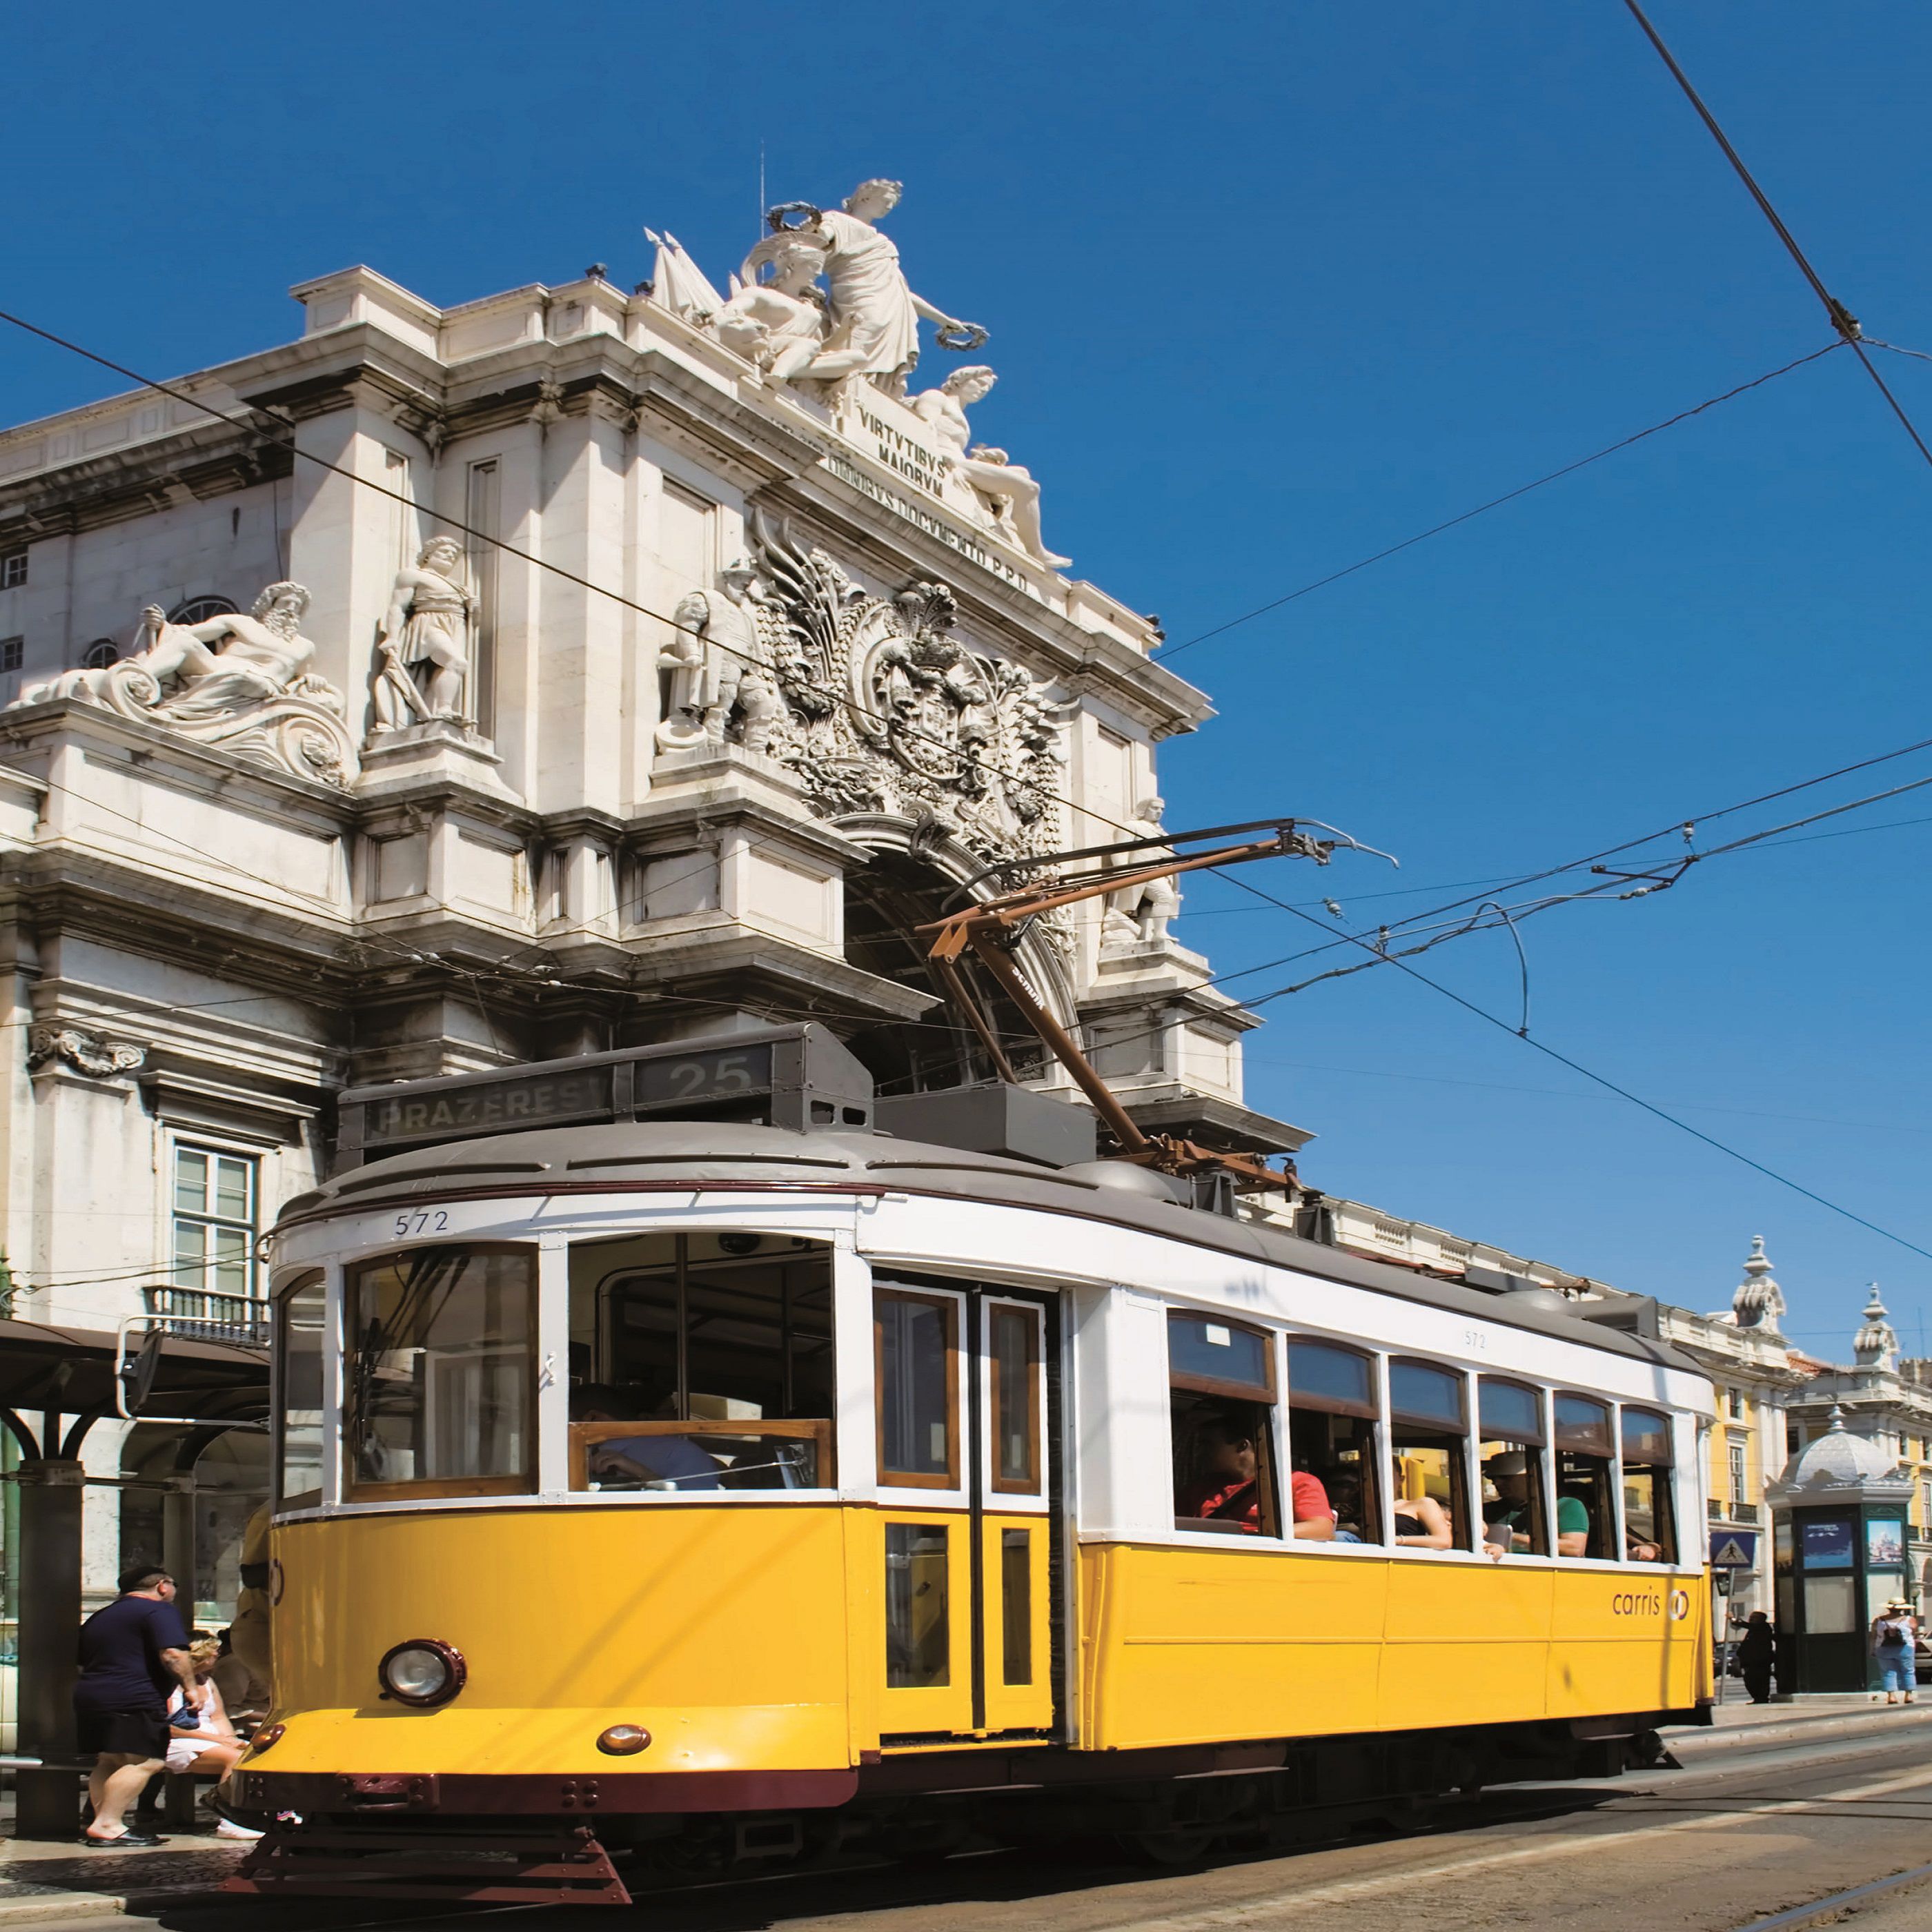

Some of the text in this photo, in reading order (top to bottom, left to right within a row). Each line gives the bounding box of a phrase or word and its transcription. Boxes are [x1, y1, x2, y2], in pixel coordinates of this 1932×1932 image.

[856, 405, 945, 479] VIRTVTIBVS
[879, 444, 943, 498] MAIORVM
[380, 1056, 751, 1132] PRAZERES 25
[395, 1211, 448, 1235] 572
[1613, 1585, 1660, 1615] carris
